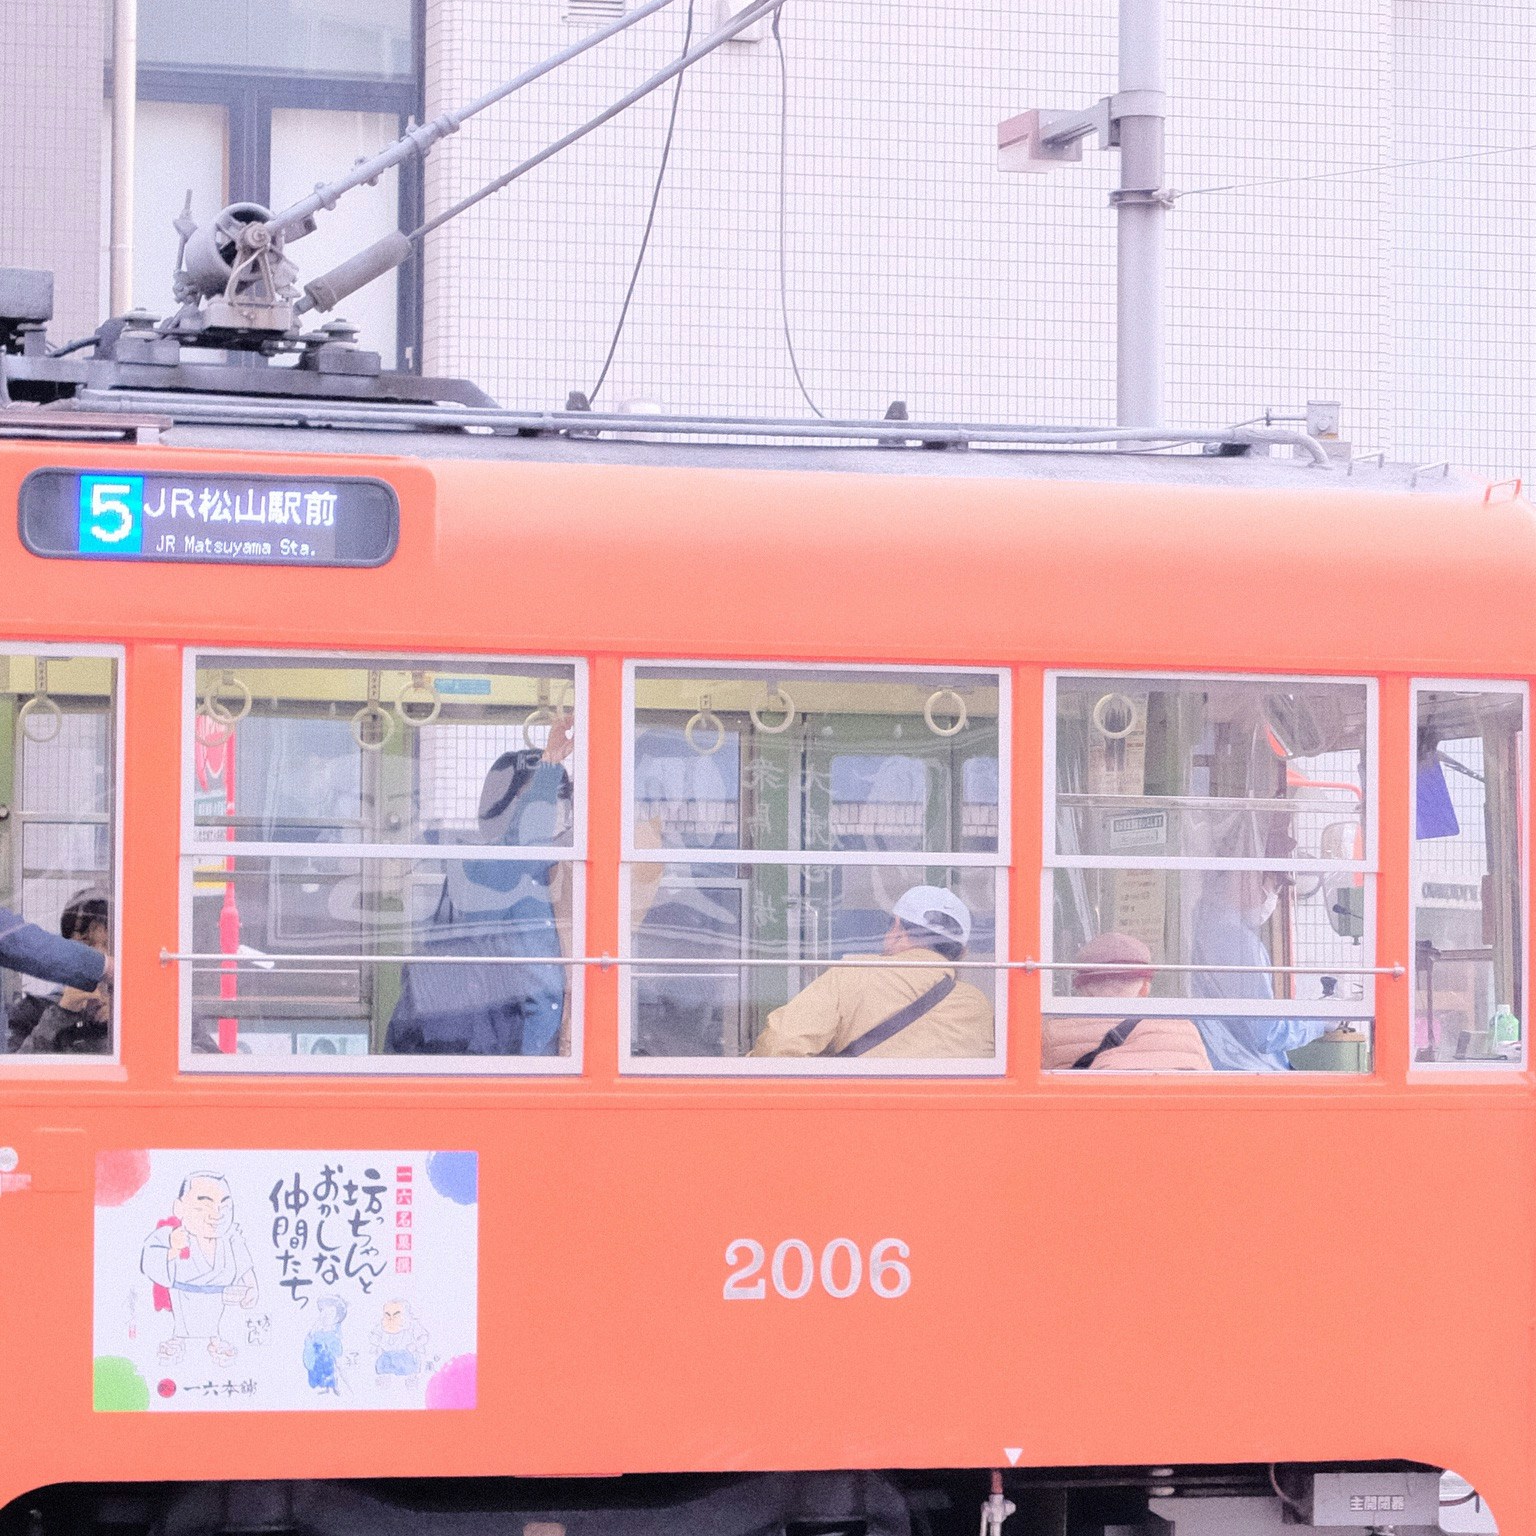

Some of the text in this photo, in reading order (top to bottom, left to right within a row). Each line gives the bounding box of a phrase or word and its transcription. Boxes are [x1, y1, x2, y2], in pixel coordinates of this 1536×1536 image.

[90, 484, 133, 542] 5
[143, 488, 338, 526] JR松山駅前
[155, 535, 317, 557] JR Matsuyama Sta.
[269, 1171, 313, 1310] 仲間たち
[312, 1164, 343, 1285] おかしな
[341, 1168, 388, 1294] 坊っちゃんと
[722, 1237, 912, 1301] 2006
